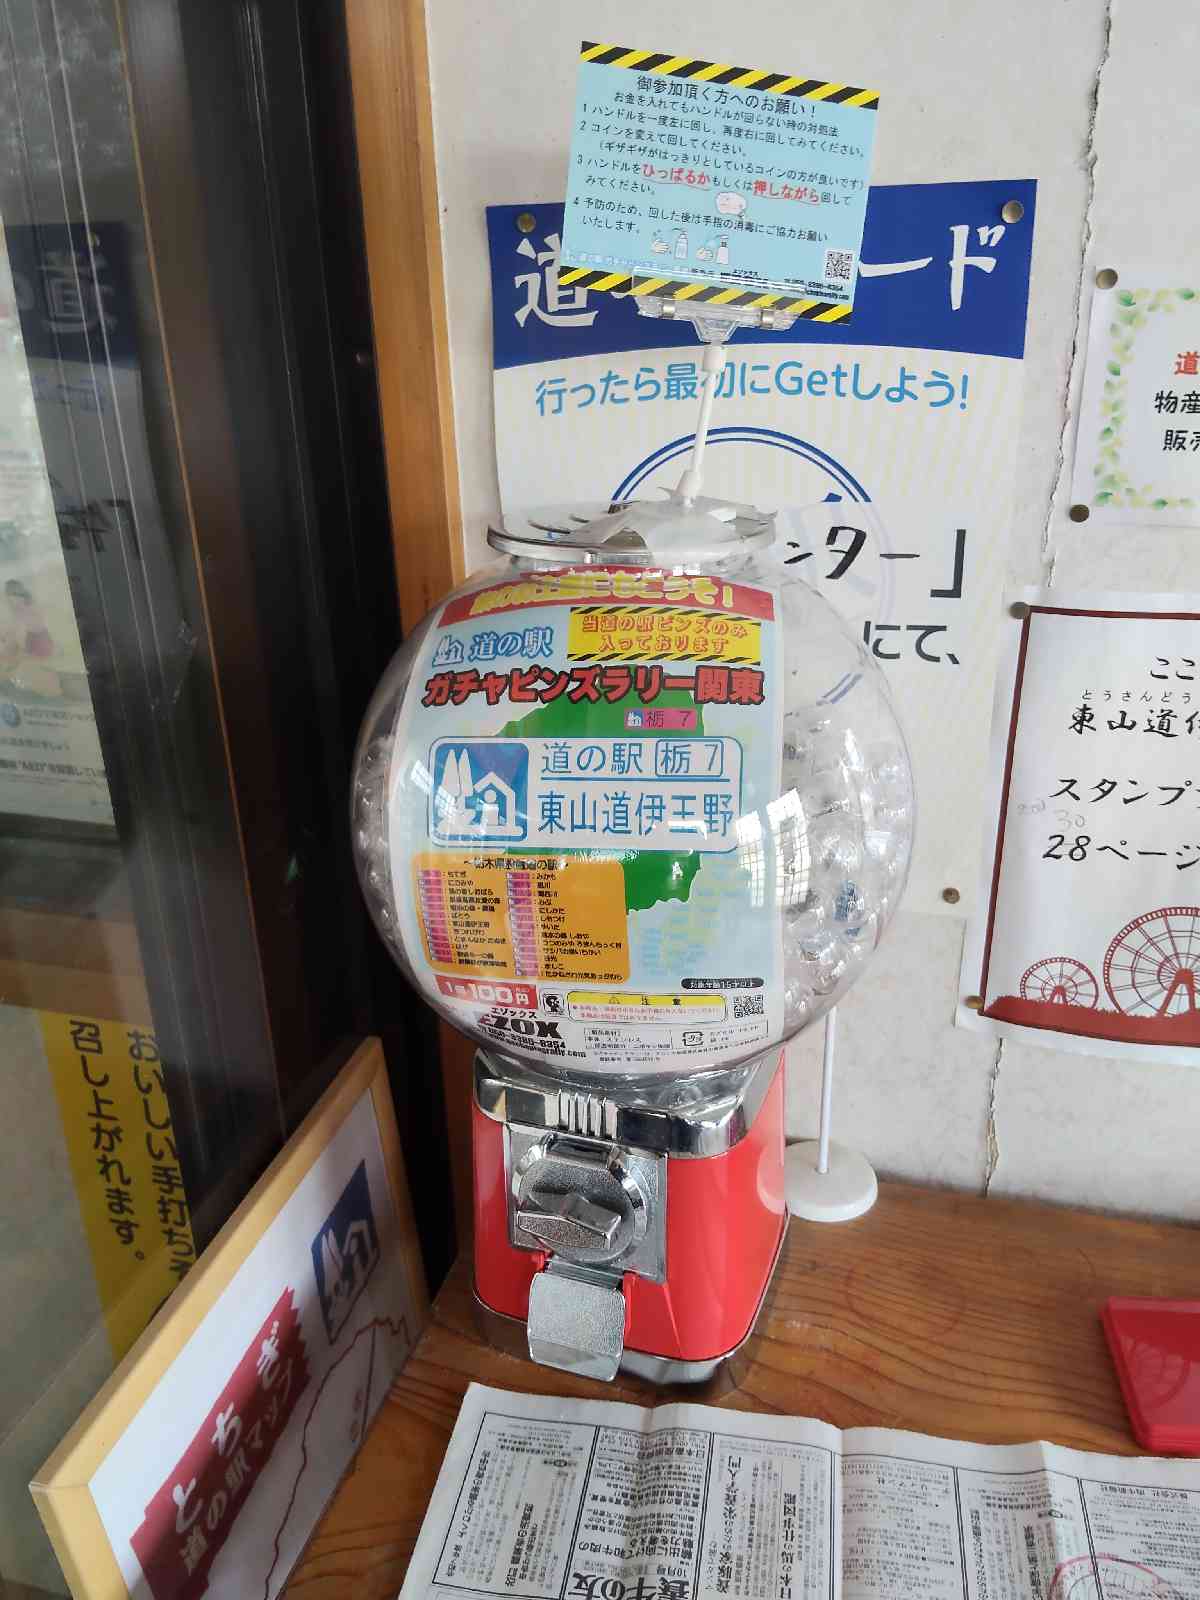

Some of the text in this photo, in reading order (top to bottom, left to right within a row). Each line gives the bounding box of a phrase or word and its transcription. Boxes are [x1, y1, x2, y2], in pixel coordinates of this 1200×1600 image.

[469, 626, 554, 662] 道の駅
[599, 635, 729, 655] 入っております
[421, 664, 765, 707] ガチャピンズラリー関東
[1082, 689, 1191, 704] とうさんどう
[541, 742, 643, 775] 道の駅
[1049, 777, 1200, 808] スタンプ
[537, 791, 733, 837] 東山道伊王野
